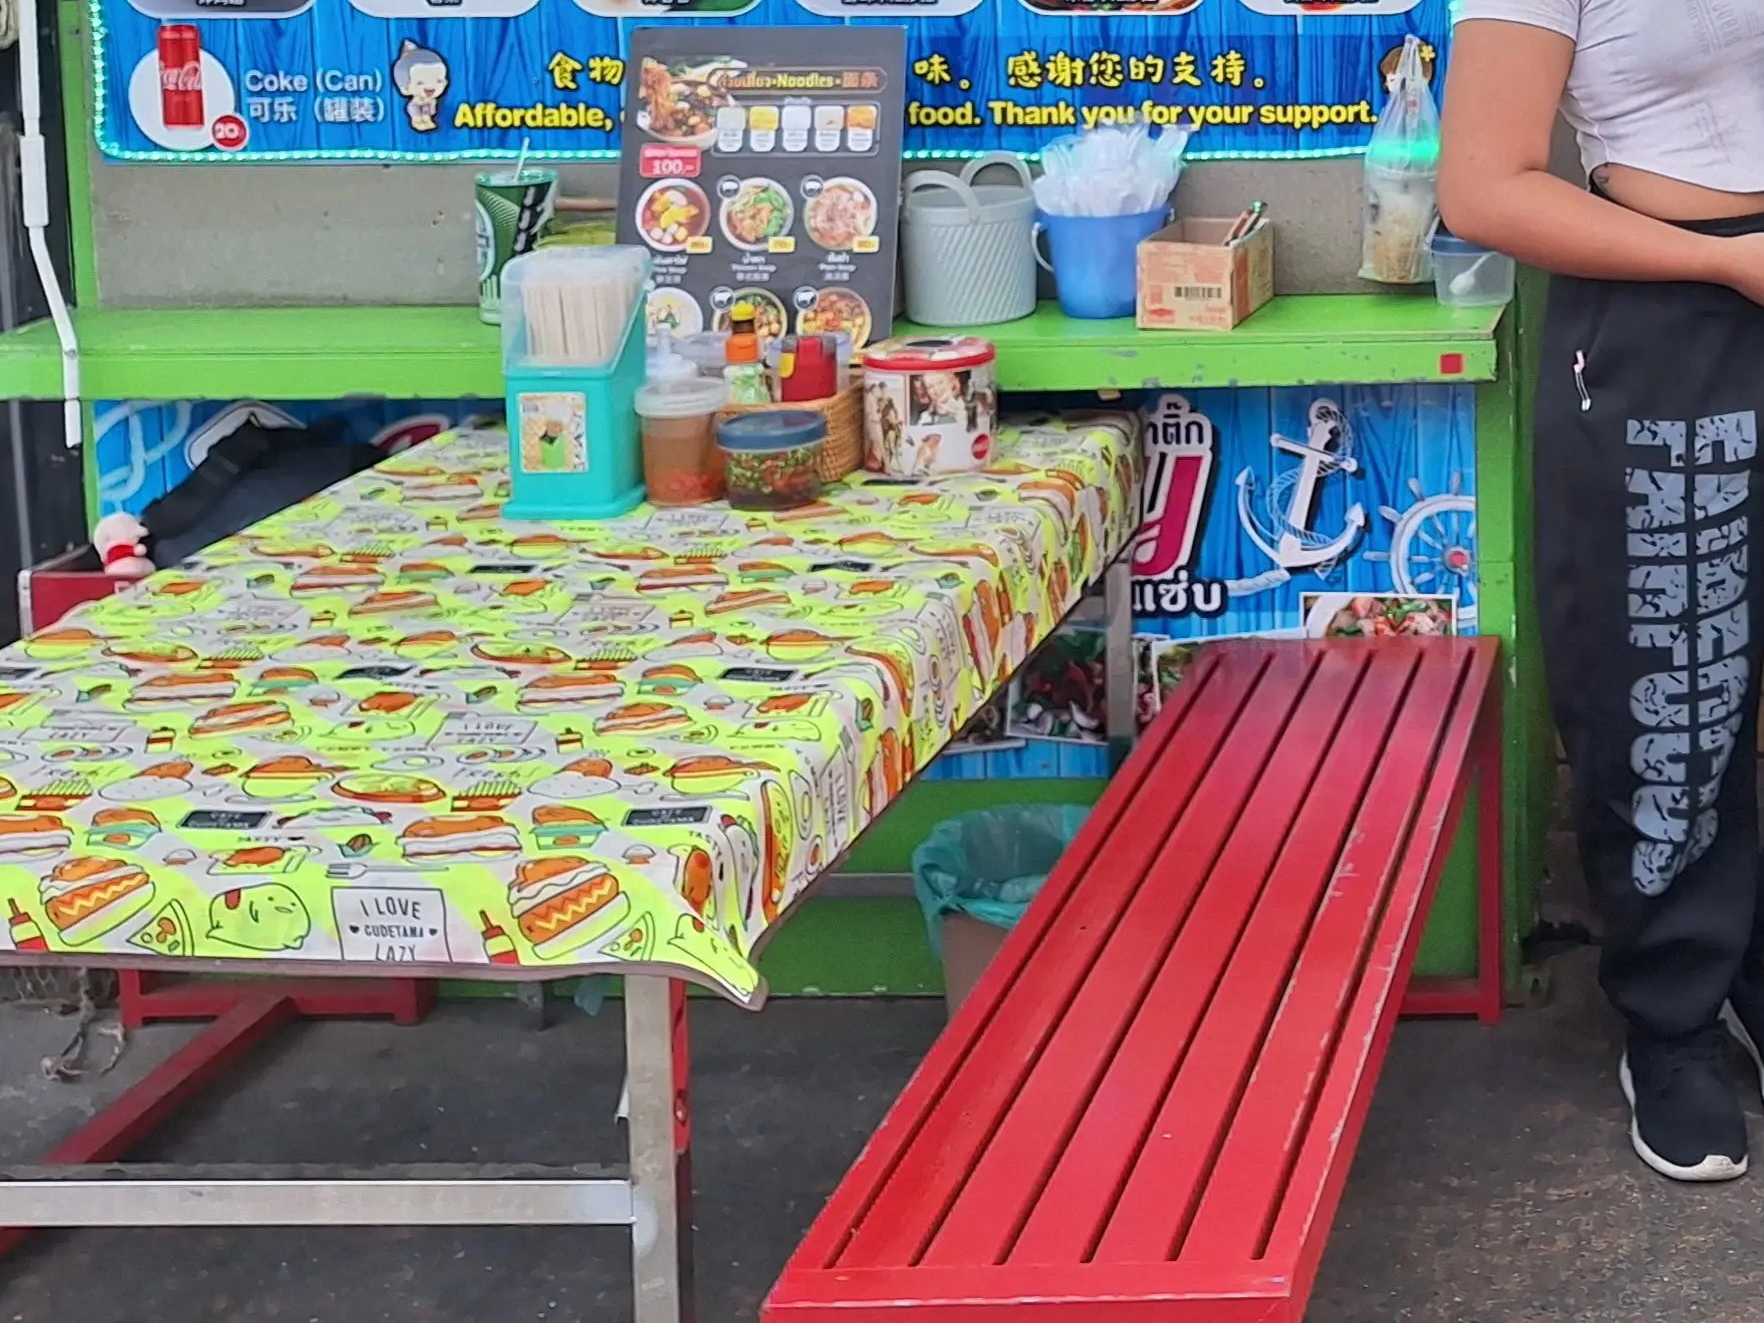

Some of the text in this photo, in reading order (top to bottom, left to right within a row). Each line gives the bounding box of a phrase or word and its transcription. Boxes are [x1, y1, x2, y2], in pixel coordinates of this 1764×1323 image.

[245, 68, 383, 93] Coke (Can)
[778, 73, 833, 88] Noodles
[1007, 49, 1266, 90] 感谢您的支持。
[454, 100, 1378, 132] Affordable, food. Thank you for your support.
[375, 897, 421, 920] LOVE
[376, 943, 416, 961] LAZY
